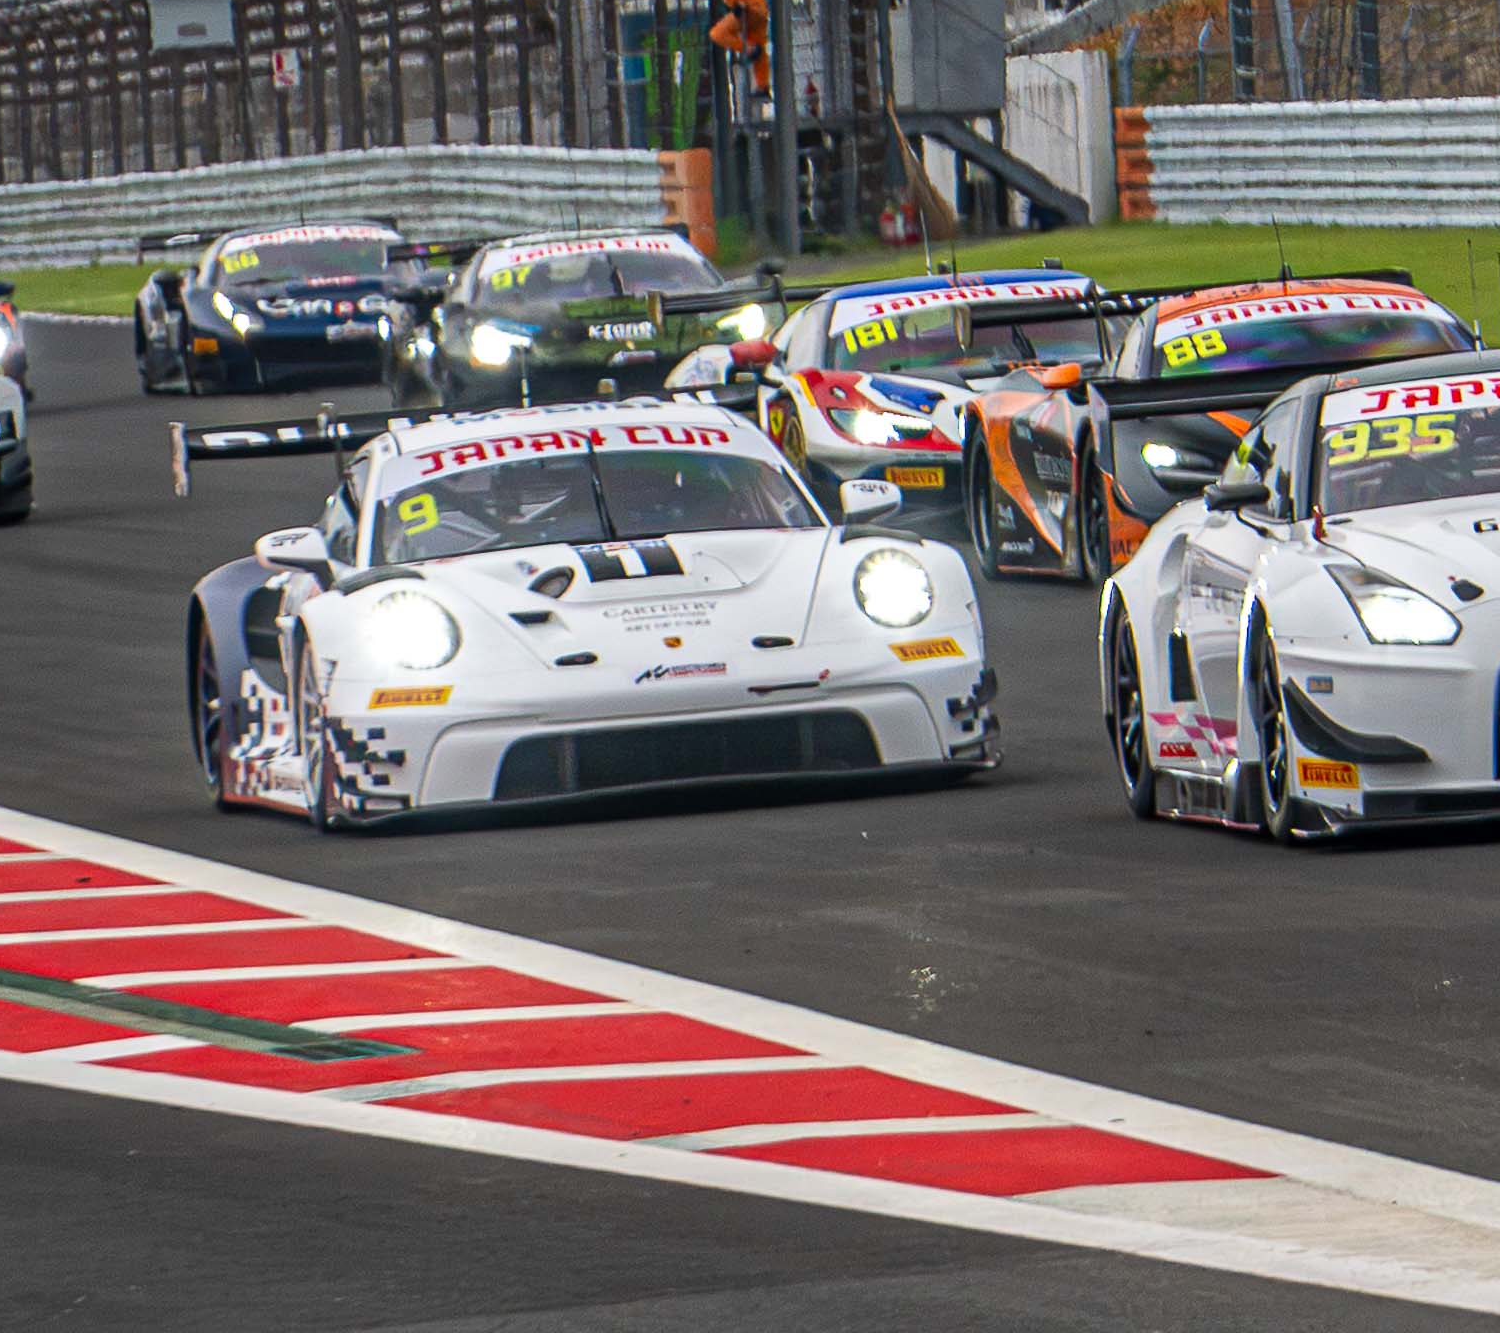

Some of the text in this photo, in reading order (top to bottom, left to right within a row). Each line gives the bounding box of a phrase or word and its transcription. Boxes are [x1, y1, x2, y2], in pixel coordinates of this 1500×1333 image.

[864, 283, 1084, 318] JAPAN CUP
[1185, 297, 1330, 331] JAPAN
[1340, 295, 1428, 312] CUP
[844, 317, 899, 355] 181
[1162, 328, 1228, 368] 88
[414, 423, 732, 477] JAPAN CUP
[1328, 413, 1457, 466] 935
[399, 491, 440, 536] 9
[896, 640, 958, 658] PIRELLI
